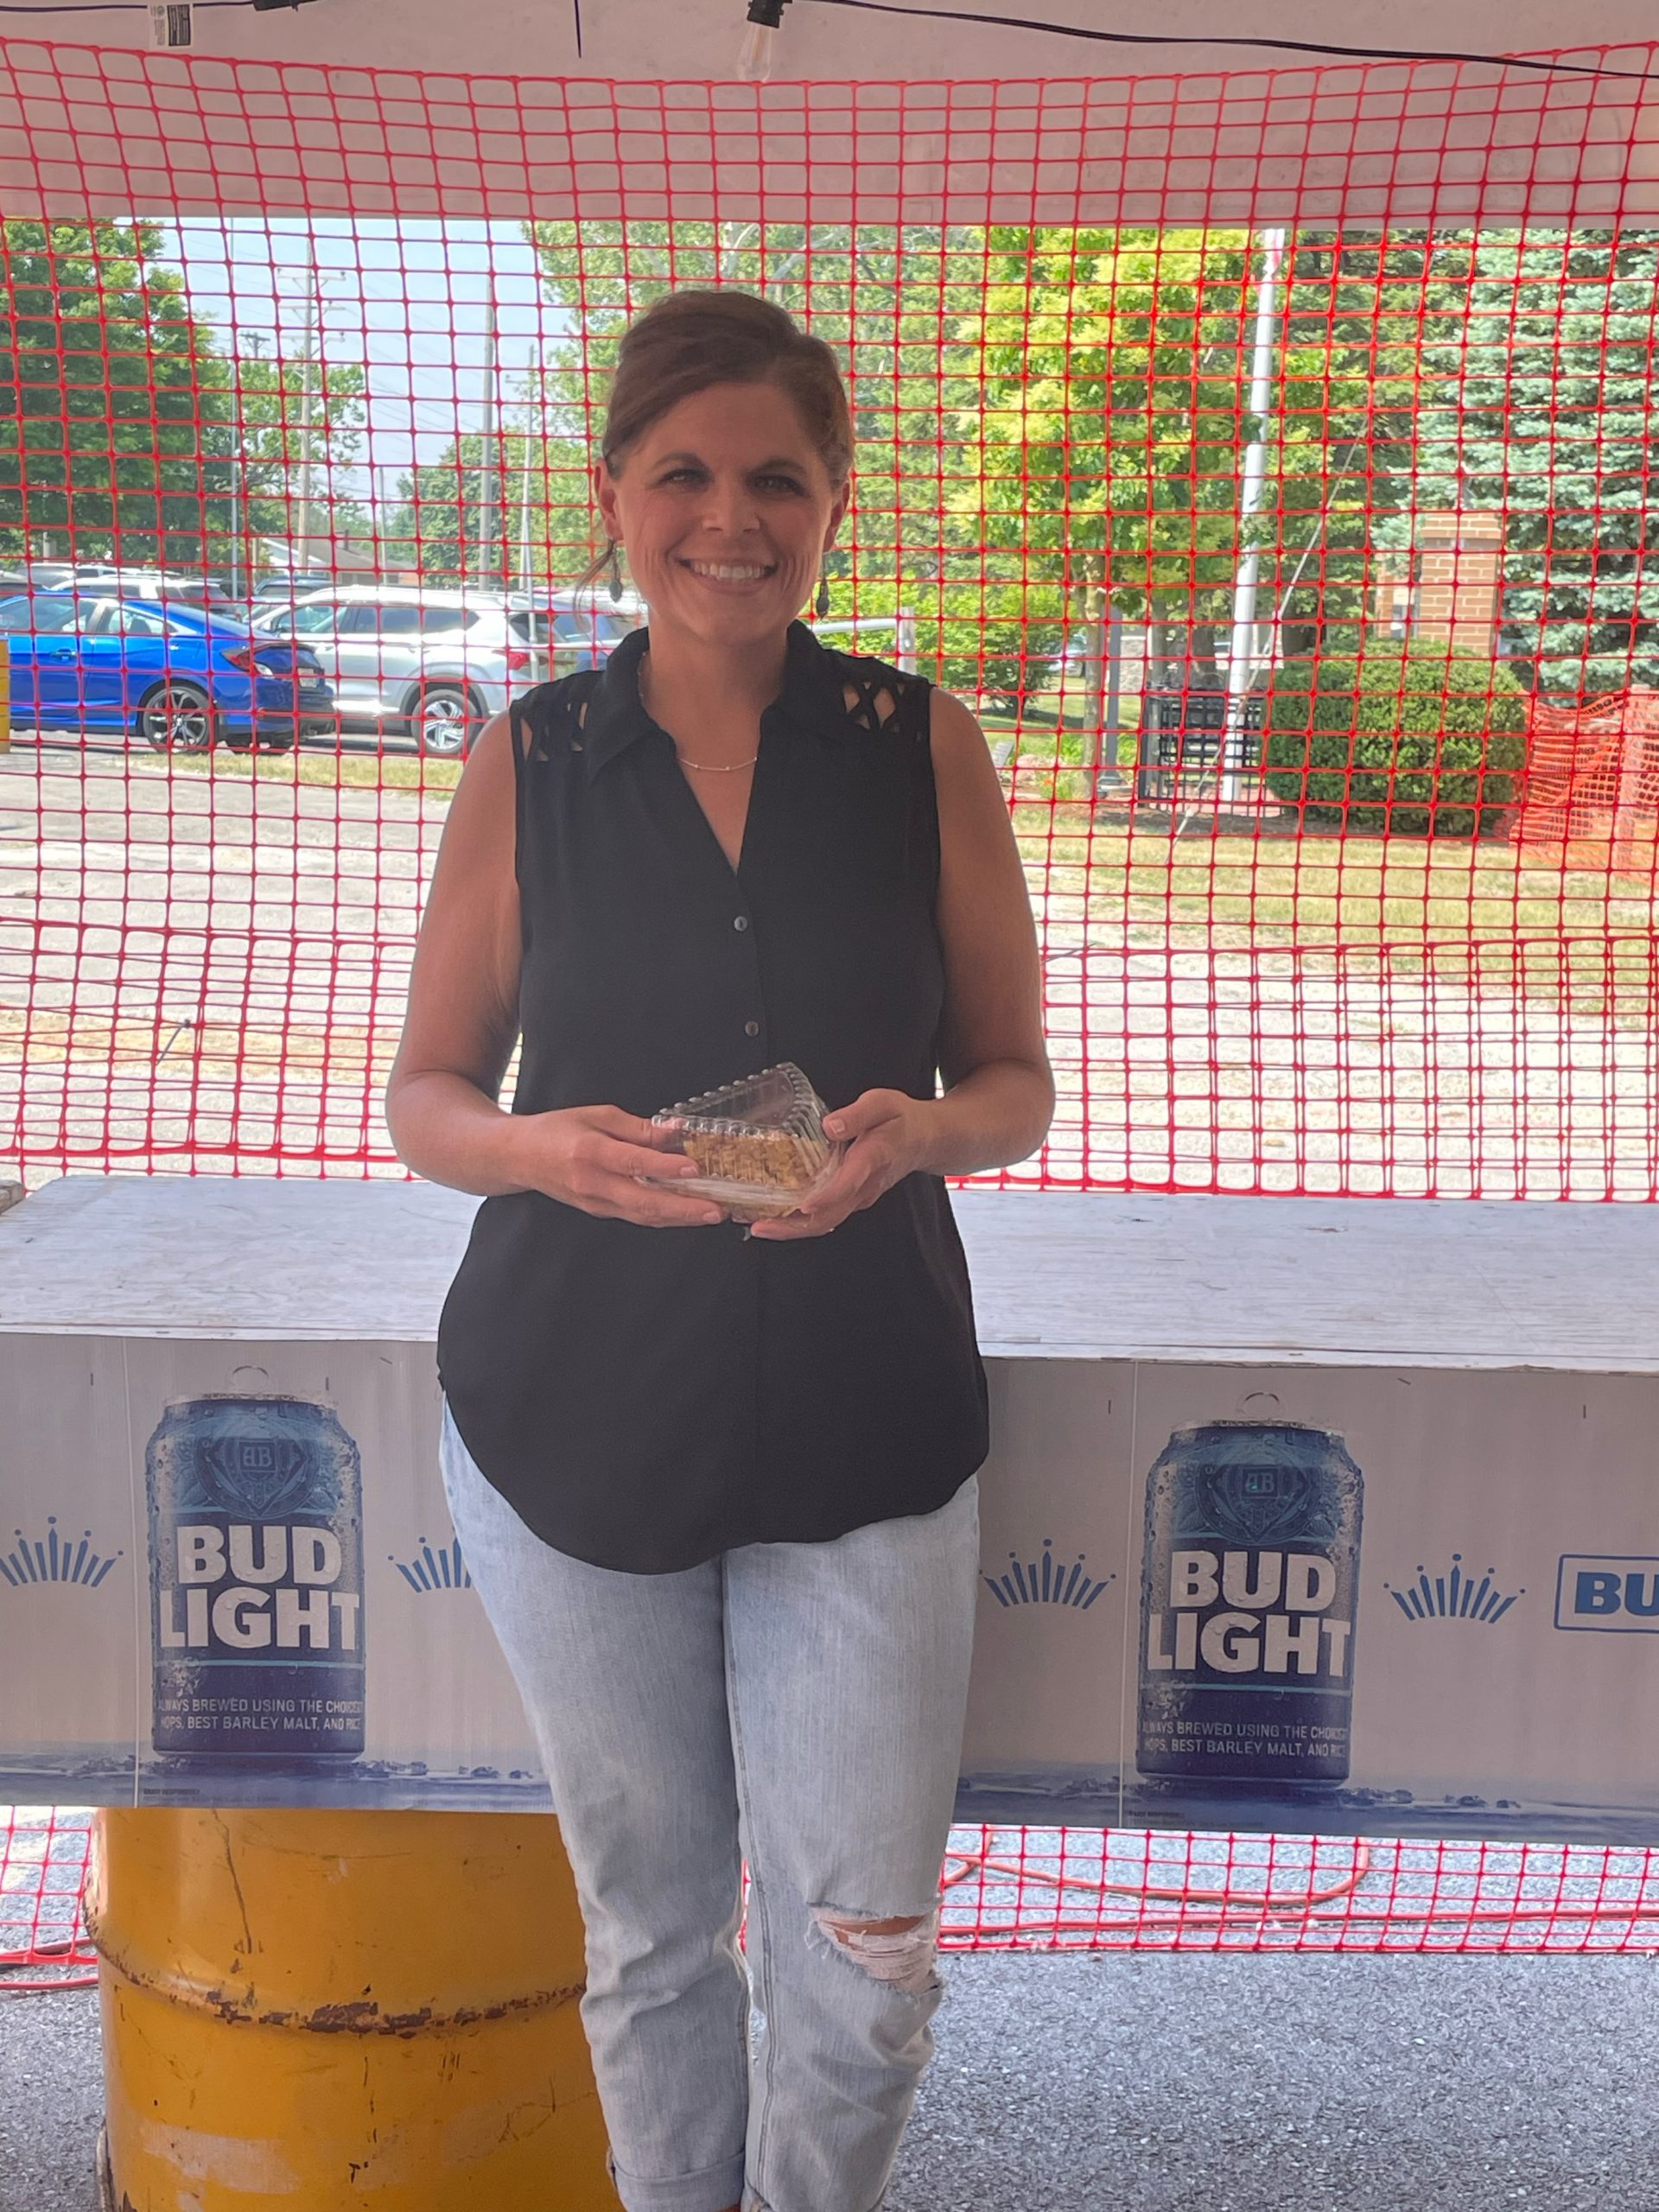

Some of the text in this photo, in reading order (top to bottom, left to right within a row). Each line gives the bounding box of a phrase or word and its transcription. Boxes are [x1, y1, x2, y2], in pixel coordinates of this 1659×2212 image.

[176, 1525, 342, 1585] BUD
[1169, 1550, 1337, 1611] BUD
[160, 1586, 360, 1650] LIGHT
[1147, 1611, 1351, 1677] LIGHT
[188, 1716, 219, 1729] BEST
[223, 1716, 278, 1730] BARLEY
[283, 1717, 320, 1731] MALT,
[323, 1718, 344, 1730] AND
[192, 1699, 248, 1712] BREWED
[252, 1699, 295, 1712] USING
[299, 1700, 322, 1713] THE
[1172, 1738, 1203, 1752] BEST
[1206, 1740, 1262, 1755] BARLEY
[1267, 1743, 1304, 1758] MALT,
[1308, 1744, 1328, 1757] AND
[1177, 1721, 1232, 1736] BREWED
[1236, 1724, 1280, 1738] USING
[1284, 1725, 1307, 1738] THE
